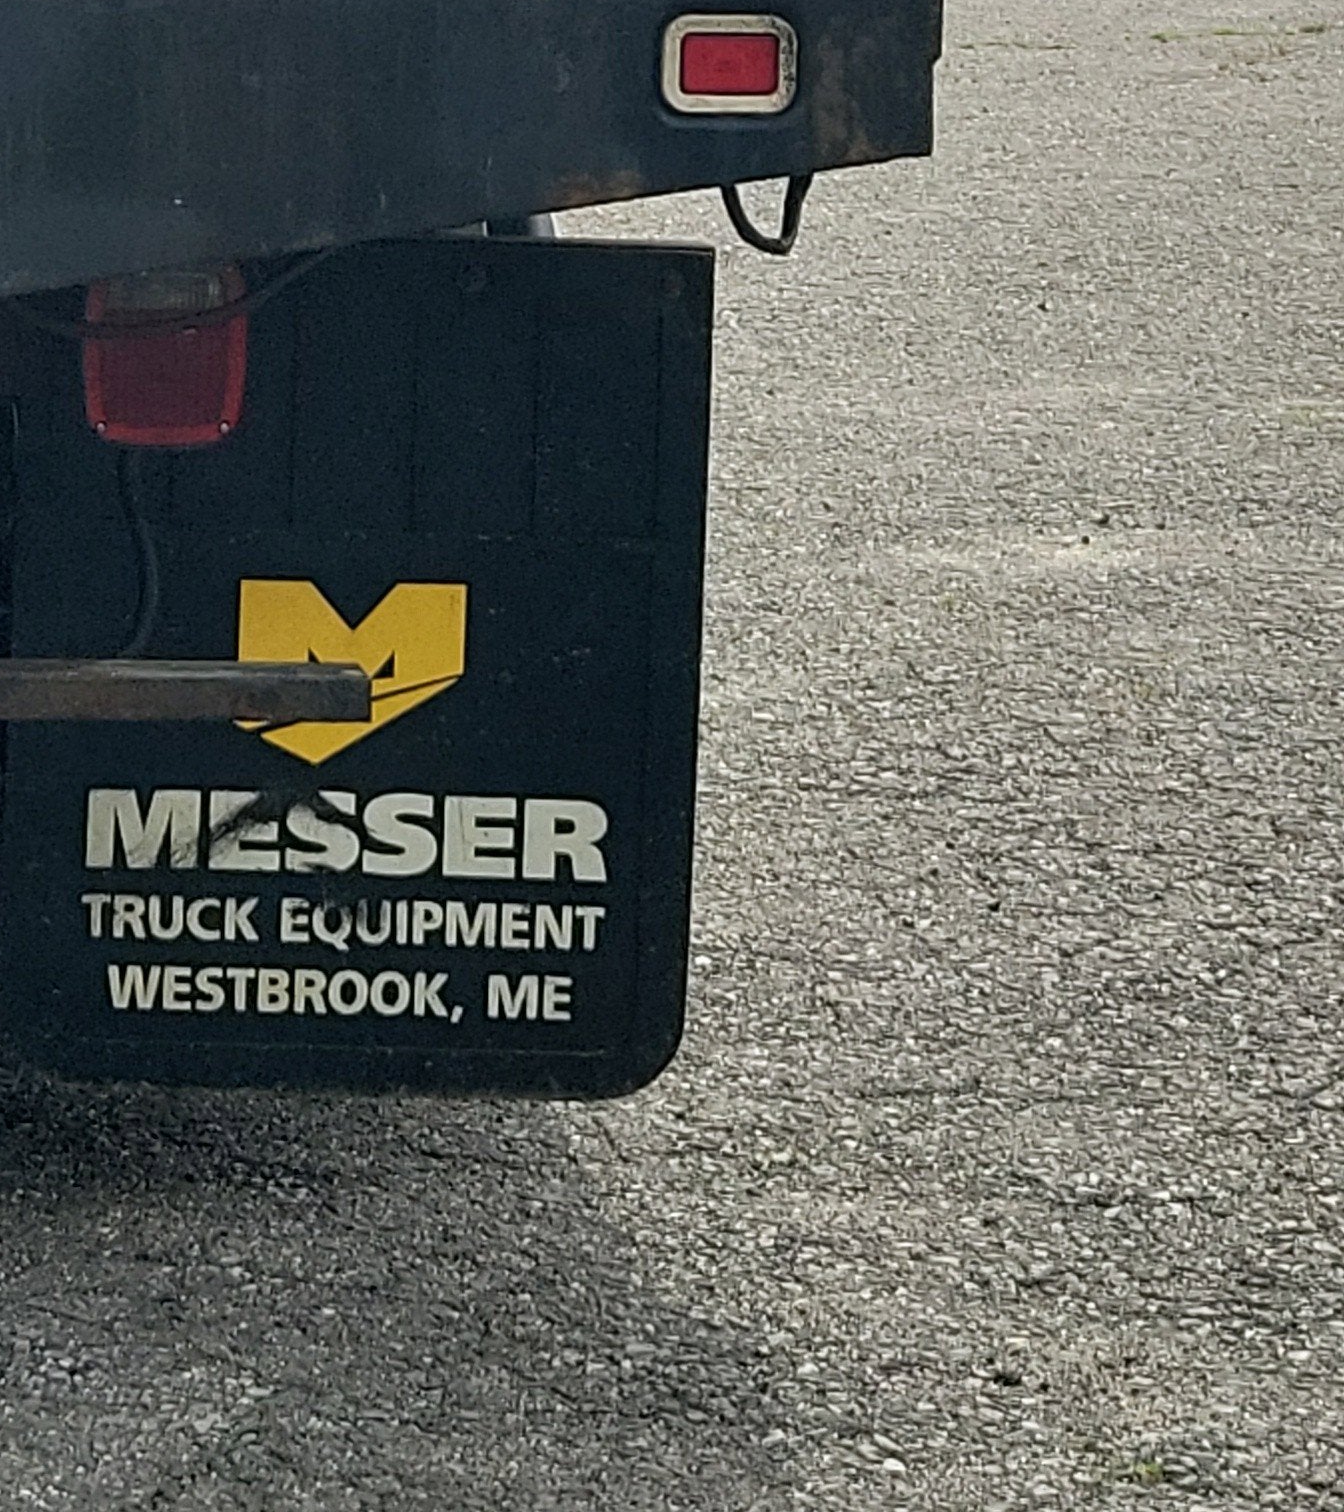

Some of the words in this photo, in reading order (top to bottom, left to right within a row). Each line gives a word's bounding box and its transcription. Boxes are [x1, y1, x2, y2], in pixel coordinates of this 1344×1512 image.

[85, 788, 609, 883] MESSER
[80, 893, 260, 943] TRUCK
[279, 896, 607, 952] EQUIPMENT
[107, 964, 465, 1024] WESTBROOK,
[486, 975, 574, 1021] ME
